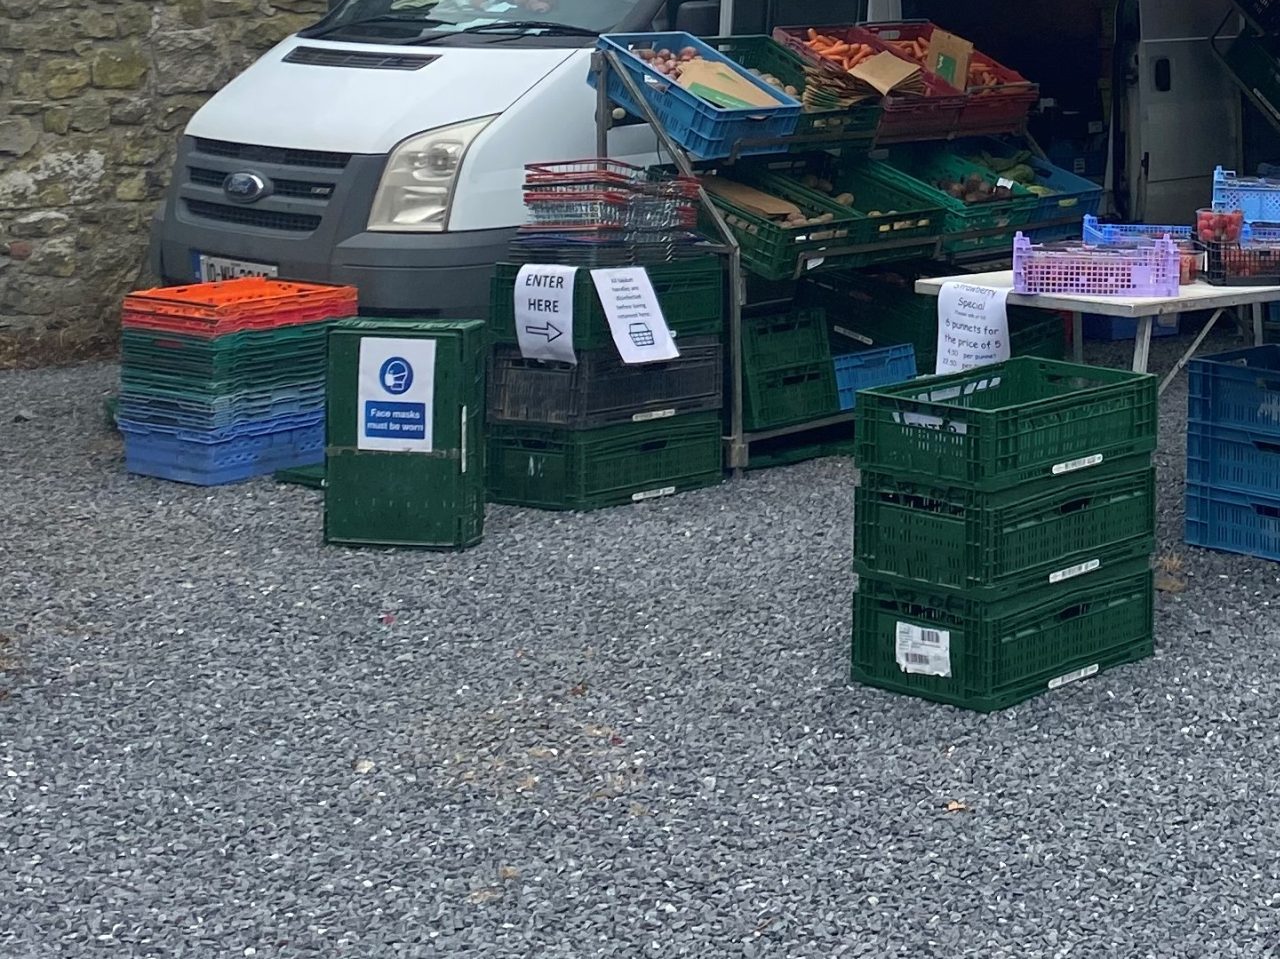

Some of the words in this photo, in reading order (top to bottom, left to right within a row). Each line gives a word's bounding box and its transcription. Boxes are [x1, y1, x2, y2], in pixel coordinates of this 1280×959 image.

[525, 273, 564, 289] ENTER
[527, 298, 560, 313] HERE
[957, 297, 986, 311] Special
[952, 321, 981, 335] punnets
[984, 326, 999, 336] for
[944, 333, 956, 345] the
[957, 337, 979, 348] price
[980, 340, 991, 350] of
[994, 340, 1001, 349] 5
[370, 408, 391, 418] Face
[392, 409, 420, 419] masks
[367, 421, 388, 430] must
[389, 422, 400, 430] be
[401, 423, 424, 432] worn
